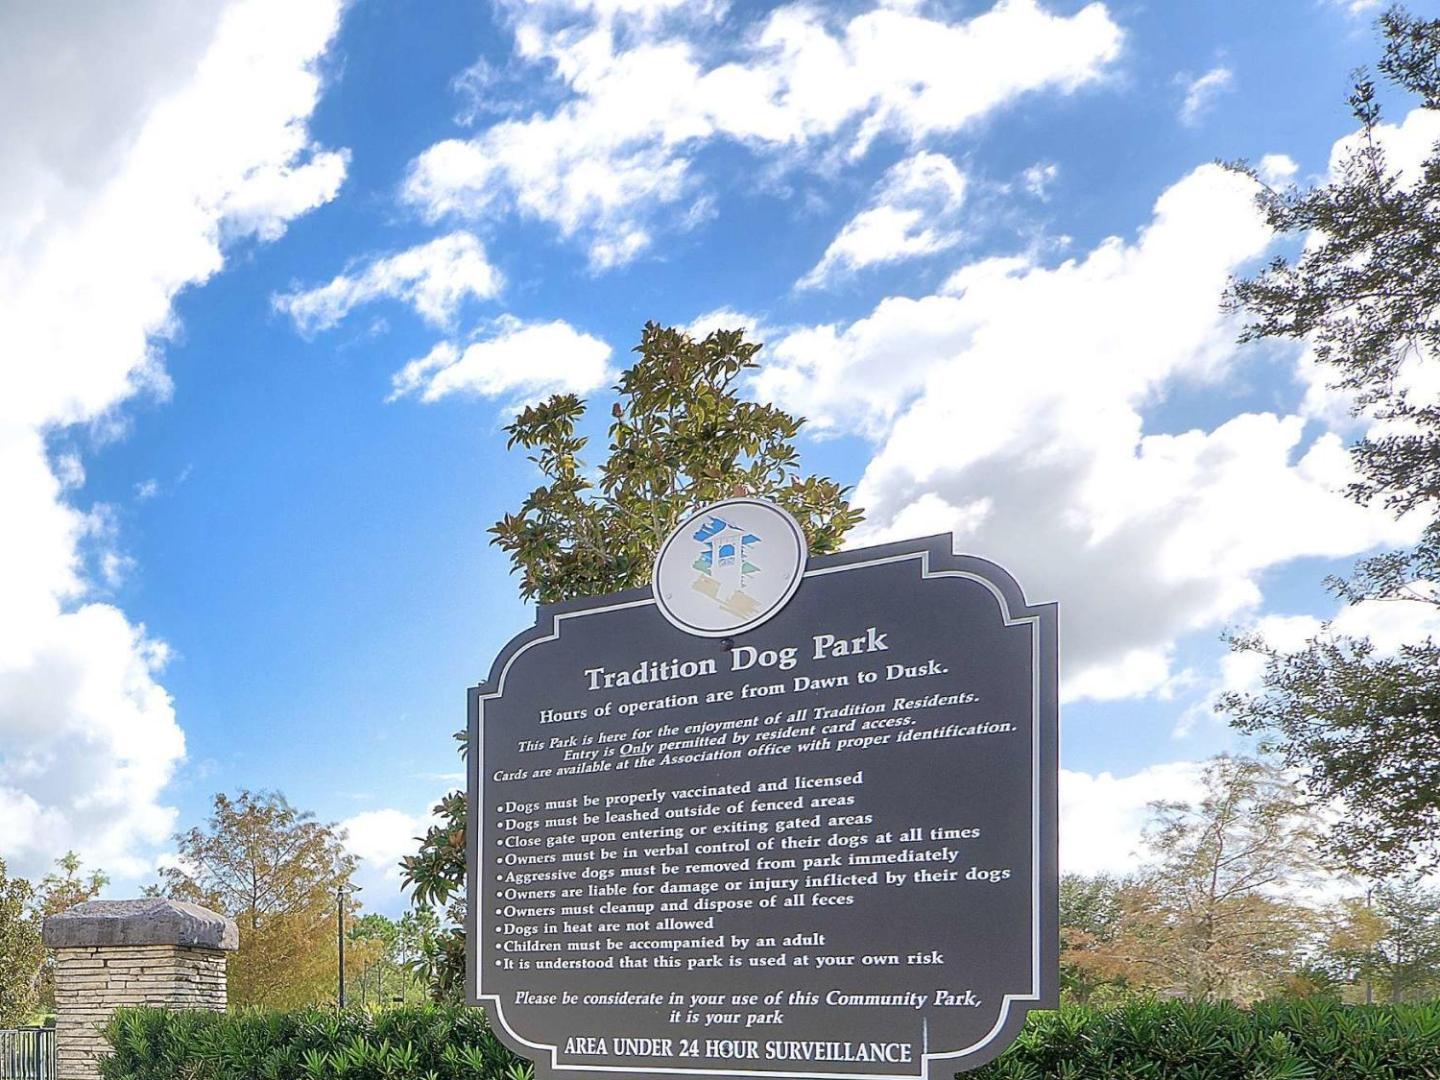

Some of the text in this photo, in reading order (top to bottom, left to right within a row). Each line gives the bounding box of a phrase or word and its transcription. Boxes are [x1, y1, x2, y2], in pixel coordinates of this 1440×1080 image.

[584, 627, 889, 691] Tradition Dog Park
[539, 659, 949, 724] Hours of operation are from Dawn to Dusk.
[517, 692, 980, 753] This Park is here for the enjoyment of all Tradition Residents.
[563, 716, 917, 761] Entry is Only permitted by resident card access.
[493, 721, 1017, 782] Cards are available at the Association office with proper identification.
[545, 797, 578, 810] must
[583, 795, 600, 807] be
[605, 788, 667, 808] properly
[671, 780, 752, 800] vaccinated
[757, 777, 789, 793] and
[794, 770, 863, 790] licensed
[545, 815, 578, 828] must
[583, 812, 600, 825] be
[605, 807, 660, 823] leashed
[665, 803, 721, 819] outside
[726, 800, 745, 814] of
[750, 795, 804, 813] fenced
[810, 795, 855, 808] areas
[546, 833, 576, 849] gate
[580, 832, 617, 845] upon
[621, 826, 685, 840] entering
[689, 825, 708, 836] or
[712, 820, 769, 834] exiting
[775, 814, 821, 833] gated
[827, 814, 873, 827] areas
[561, 850, 595, 862] must
[600, 847, 618, 860] be
[623, 847, 638, 859] in
[643, 842, 689, 857] verbal
[694, 838, 751, 855] control
[756, 837, 775, 851] of
[781, 835, 822, 849] their
[827, 833, 869, 849] dogs
[875, 831, 893, 844] at
[899, 827, 923, 842] all
[930, 827, 981, 841] times
[581, 866, 615, 881] dogs
[620, 865, 657, 877] must
[661, 862, 680, 875] be
[685, 857, 751, 874] removed
[756, 857, 797, 870] from
[802, 853, 843, 871] park
[847, 846, 959, 865] immediately
[561, 888, 583, 898] are
[587, 883, 627, 897] liable
[632, 882, 655, 895] for
[659, 881, 719, 895] damage
[724, 881, 743, 891] or
[748, 877, 799, 892] injury
[805, 871, 879, 888] inflicted
[885, 871, 907, 887] by
[913, 869, 959, 883] their
[965, 866, 1011, 883] dogs
[561, 903, 595, 915] must
[599, 901, 655, 915] cleanup
[660, 898, 689, 912] and
[693, 897, 753, 913] dispose
[759, 894, 778, 908] of
[783, 893, 806, 907] all
[811, 892, 855, 906] feces
[543, 923, 558, 934] in
[563, 921, 593, 933] heat
[597, 923, 621, 932] are
[625, 920, 651, 931] not
[655, 916, 715, 931] allowed
[567, 939, 601, 951] must
[606, 938, 624, 950] be
[628, 935, 725, 952] accompanied
[730, 935, 750, 951] by
[755, 937, 777, 947] an
[782, 932, 826, 947] adult
[518, 958, 531, 970] is
[535, 956, 615, 969] understood
[619, 955, 649, 969] that
[653, 955, 682, 968] this
[687, 954, 724, 971] park
[728, 955, 743, 967] is
[748, 953, 787, 967] used
[793, 954, 810, 966] at
[815, 955, 855, 969] your
[861, 955, 900, 965] own
[907, 950, 945, 965] risk
[514, 989, 982, 1010] Please be considerate in your use of this Community Park,
[669, 1009, 785, 1028] it is your park
[563, 1037, 912, 1063] AREA UNDER 24 HOUR SURVEILLANCE
